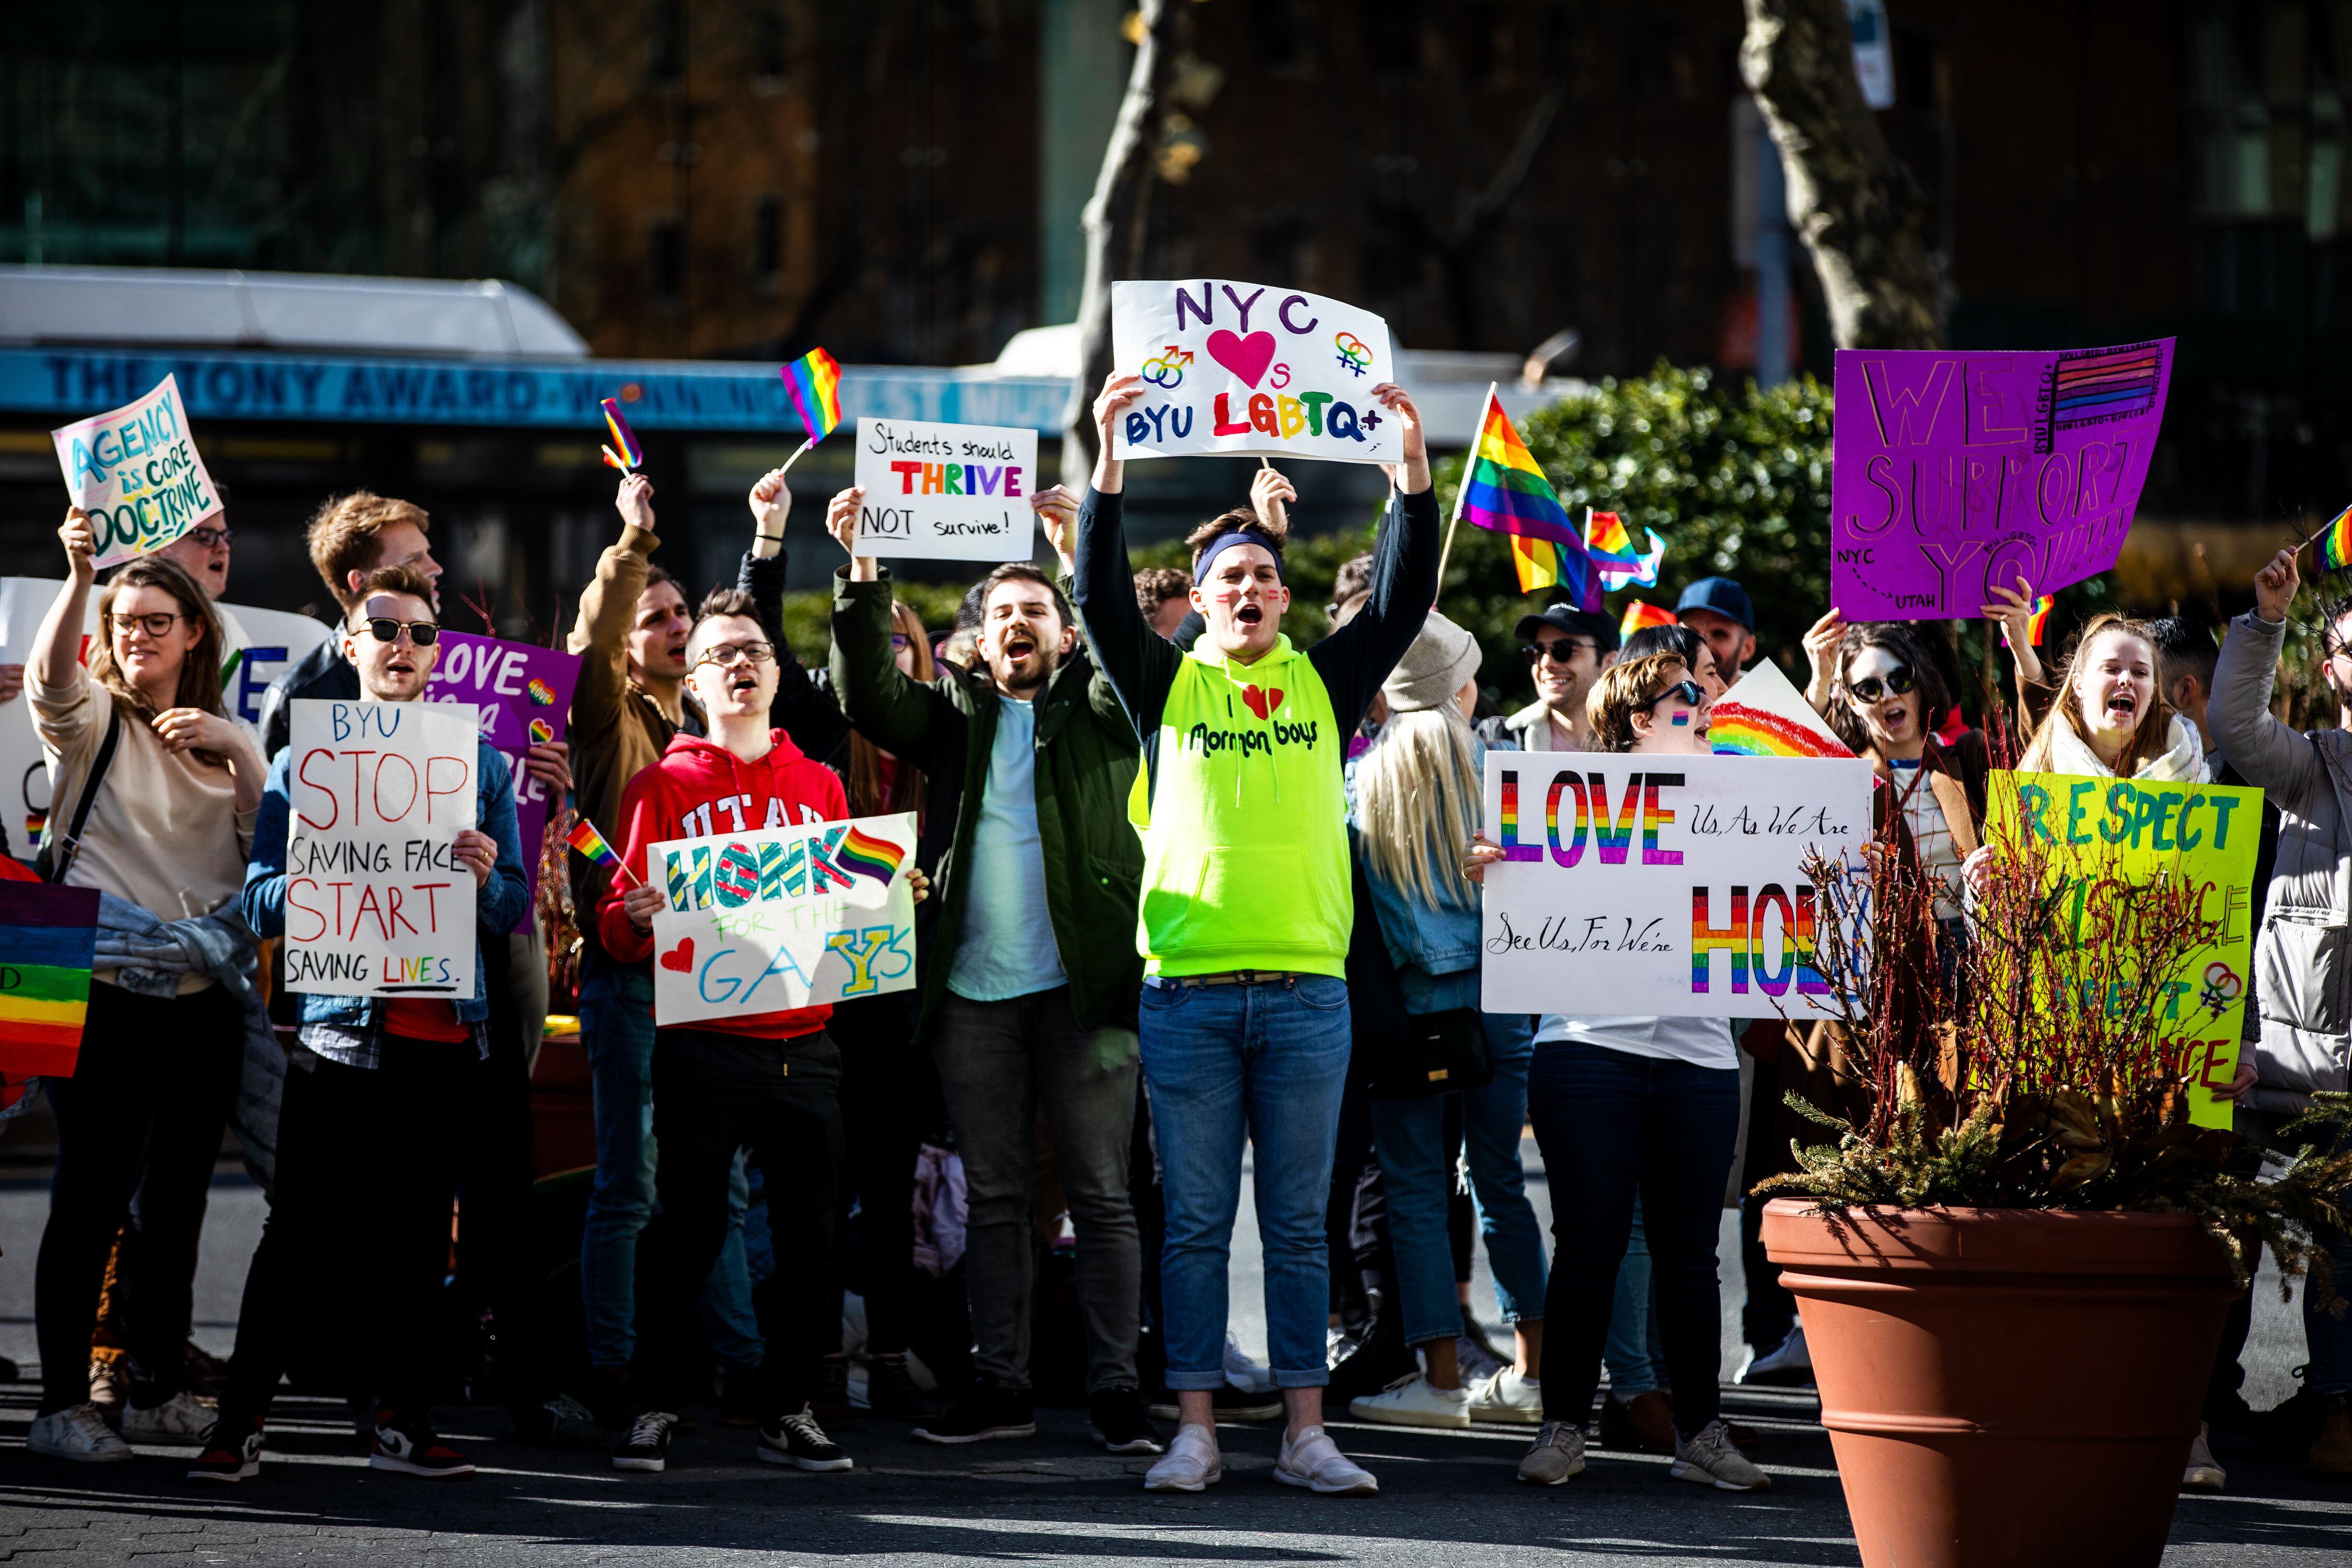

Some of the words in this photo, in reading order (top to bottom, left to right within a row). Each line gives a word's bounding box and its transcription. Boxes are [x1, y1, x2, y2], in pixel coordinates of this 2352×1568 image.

[1176, 282, 1319, 335] NYC
[177, 362, 325, 408] TONY
[1861, 358, 2028, 448] WE
[72, 390, 179, 490] AGENCY
[869, 422, 953, 454] Students
[962, 439, 1015, 460] should
[1126, 403, 1193, 446] BYU
[1213, 391, 1382, 443] LGBTQ+
[2034, 426, 2047, 454] BYU
[118, 471, 143, 494] is
[146, 440, 191, 487] CORE
[891, 460, 1022, 497] THRIVE
[1846, 423, 2155, 541] SUPPORT
[87, 465, 211, 557] DOCTRINE
[861, 506, 914, 535] NOT
[933, 511, 1010, 536] survive!
[1838, 548, 1875, 565] NYC
[1984, 537, 2002, 554] BYU
[1895, 594, 1936, 609] UTAH
[429, 642, 528, 696] OVE
[530, 683, 551, 706] LOVE
[332, 704, 401, 742] BYU
[1273, 720, 1318, 751] boys
[297, 748, 468, 831] STOP
[1501, 769, 1686, 868] LOVE
[1691, 804, 1723, 837] Us,
[1724, 804, 1761, 835] As
[1768, 805, 1805, 835] We
[1798, 806, 1850, 835] Are
[2021, 781, 2240, 852] RESPECT
[291, 836, 391, 875] SAVING
[405, 839, 467, 873] FACE
[666, 825, 857, 913] HONK
[287, 878, 451, 942] START
[710, 910, 775, 943] FOR
[786, 903, 852, 931] THE
[1486, 912, 1537, 954] See
[1539, 916, 1577, 953] Us,
[1578, 915, 1611, 952] For
[286, 949, 368, 983] SAVING
[383, 955, 461, 984] LIVES.
[699, 925, 912, 1005] GAYS
